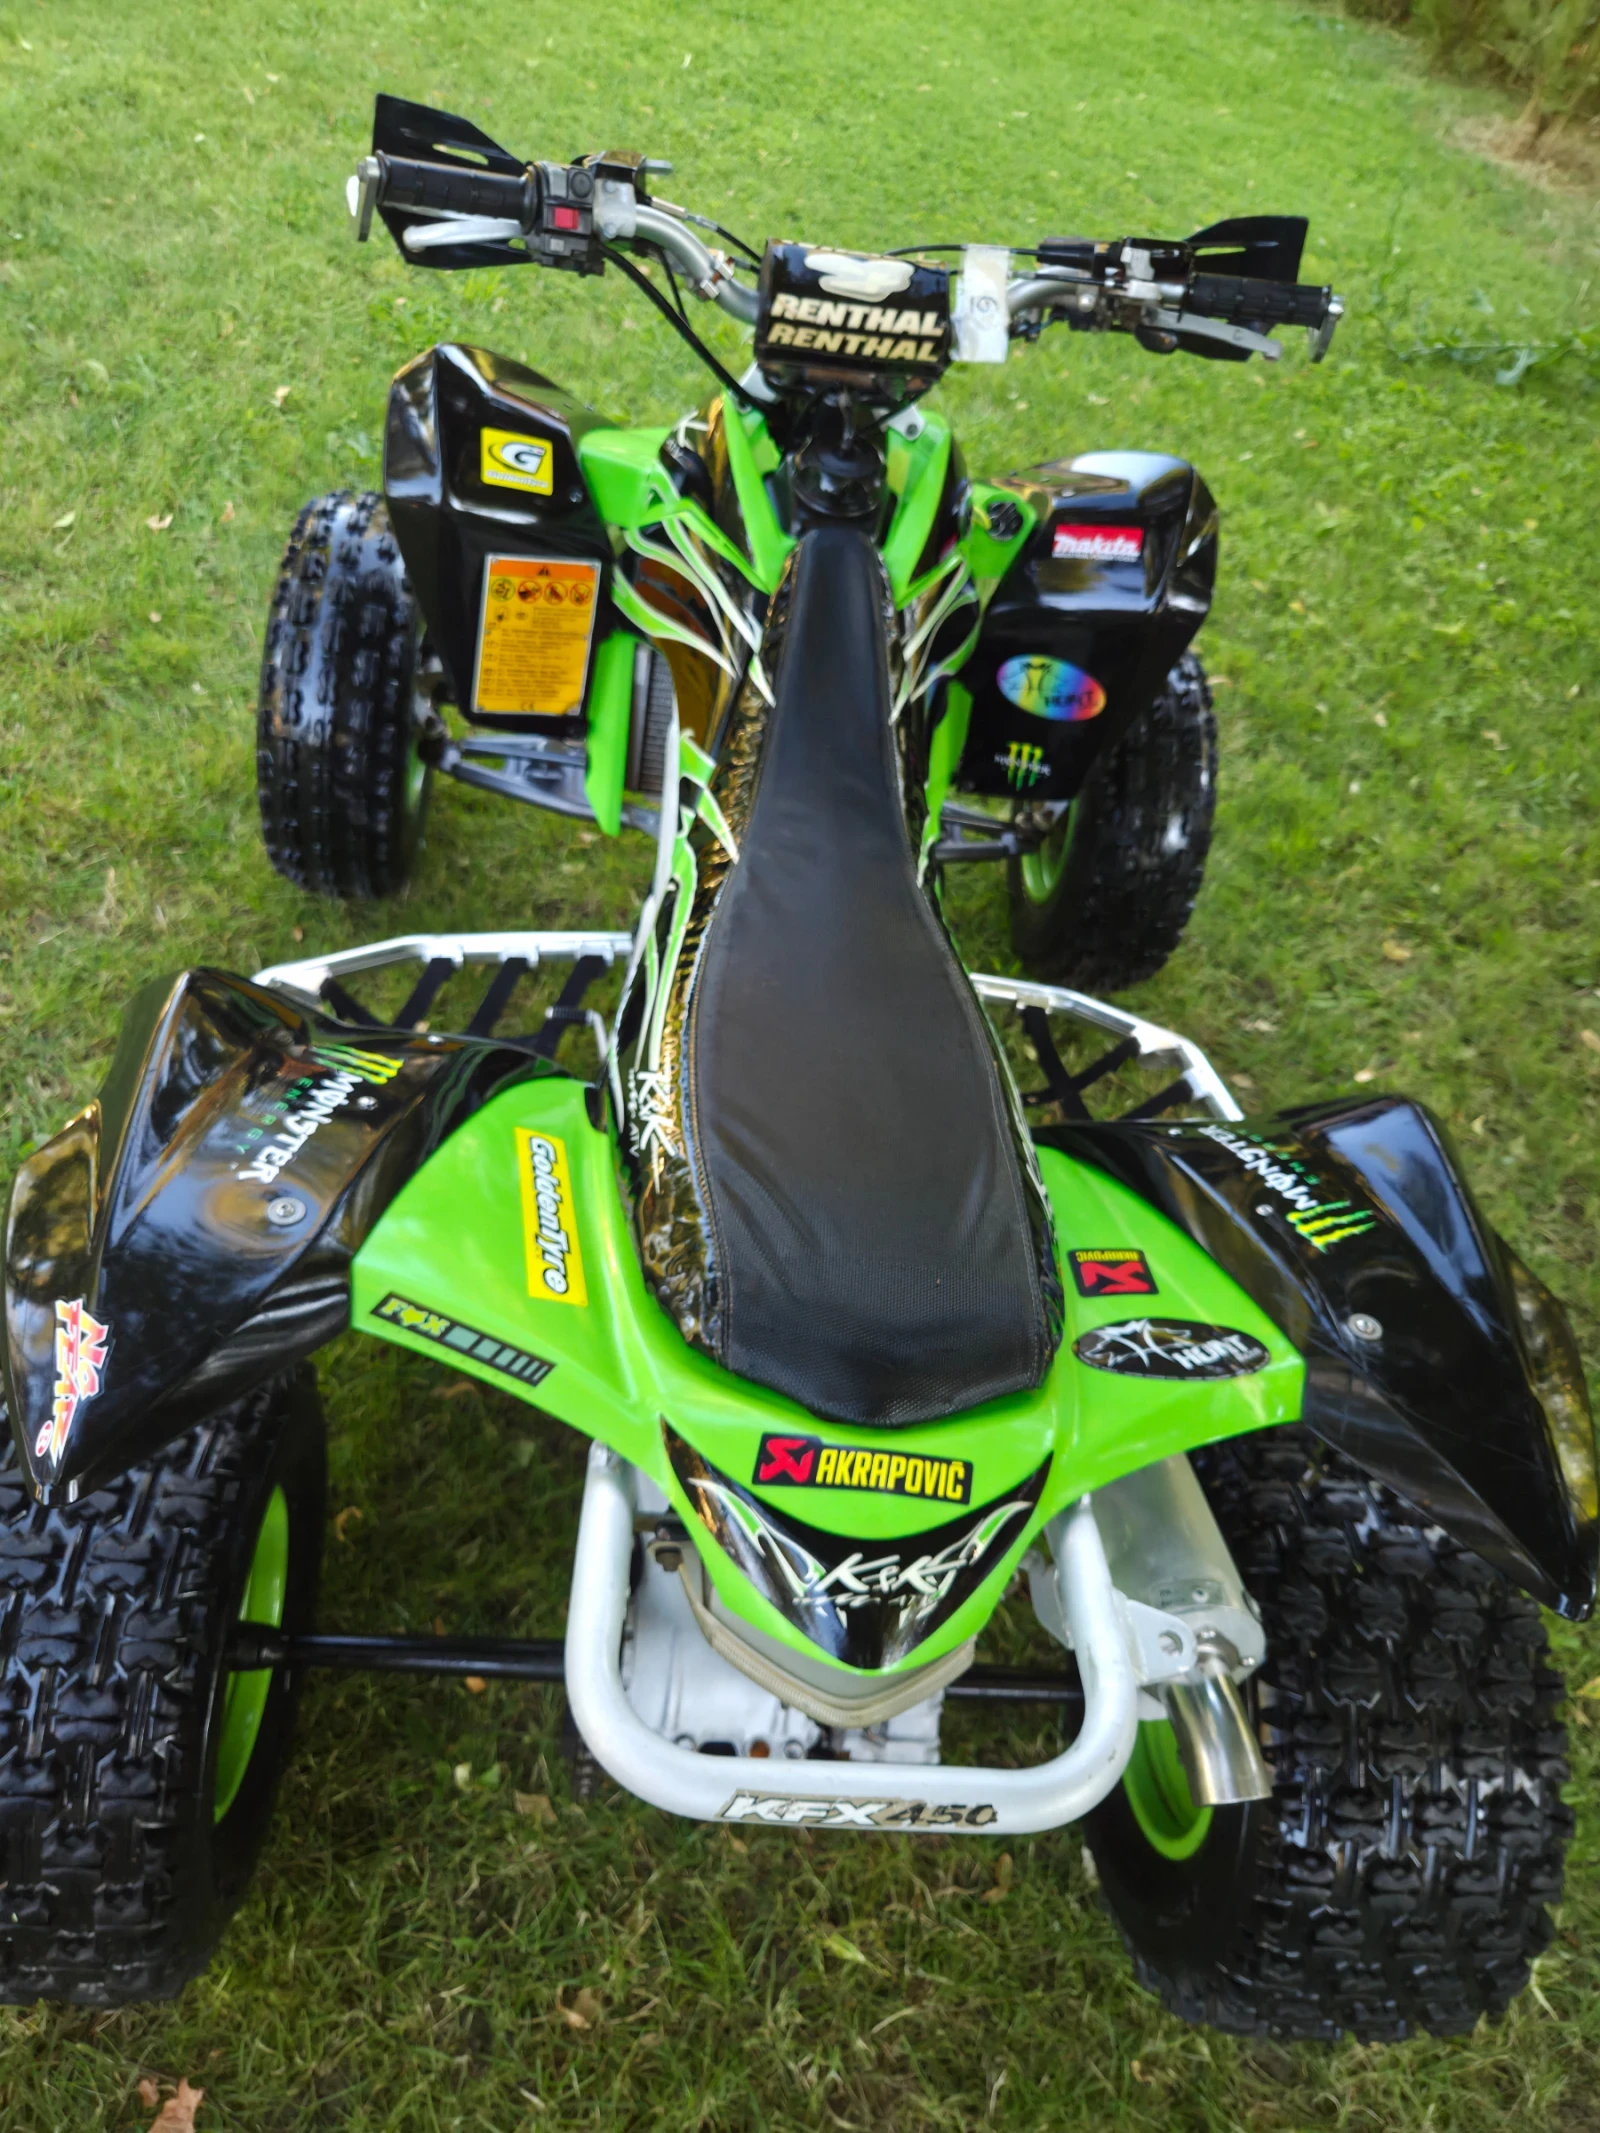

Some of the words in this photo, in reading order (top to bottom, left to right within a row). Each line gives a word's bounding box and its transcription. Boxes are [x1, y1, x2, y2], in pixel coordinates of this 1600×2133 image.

[767, 323, 940, 363] RENTHAL
[770, 292, 944, 338] RENTHAL
[235, 1076, 314, 1155] ENERGY
[238, 1070, 364, 1184] MONSTER
[1198, 1124, 1319, 1211] MONSTER
[530, 1136, 571, 1294] GoldenTyre
